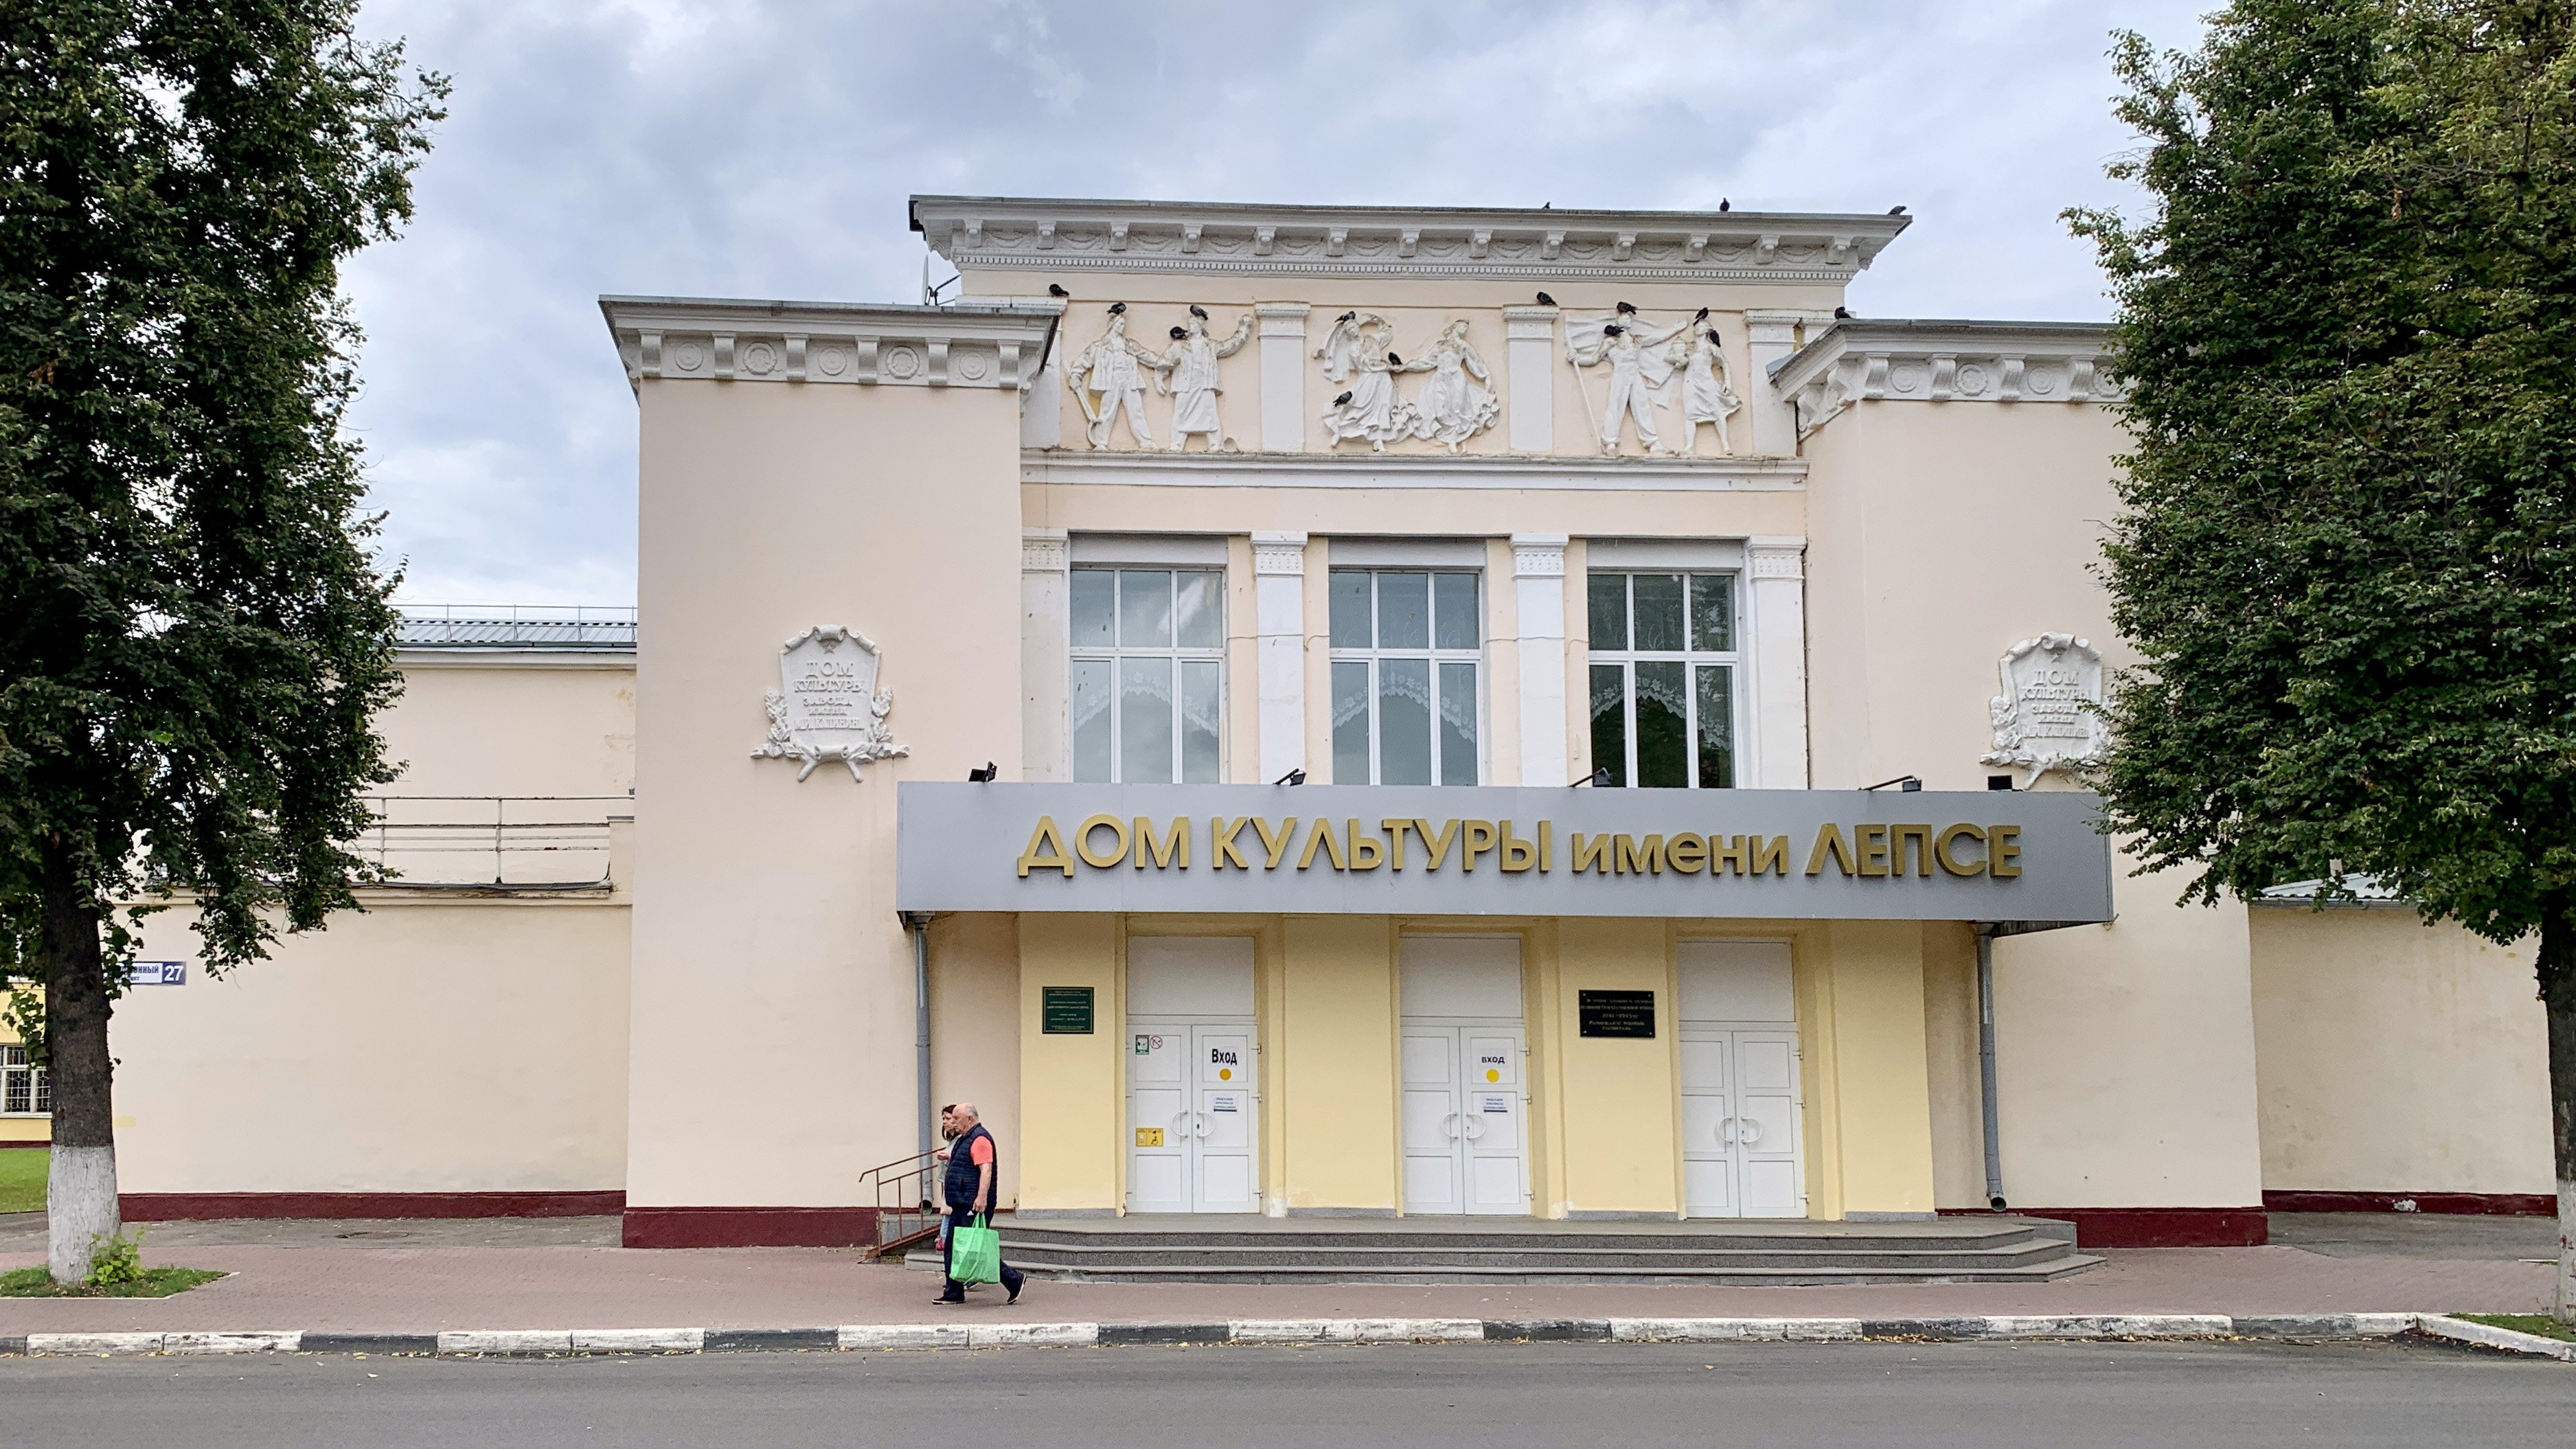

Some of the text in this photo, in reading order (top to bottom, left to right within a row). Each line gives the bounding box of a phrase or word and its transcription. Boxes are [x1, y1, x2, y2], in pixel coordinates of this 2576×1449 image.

[806, 662, 854, 678] ДОМ
[2033, 670, 2079, 687] ДОМ
[1017, 814, 2022, 878] ДОМ КУЛЬТУРЫ имени ЛЕПСЕ
[163, 965, 184, 981] 27
[1211, 1048, 1238, 1066] Вход
